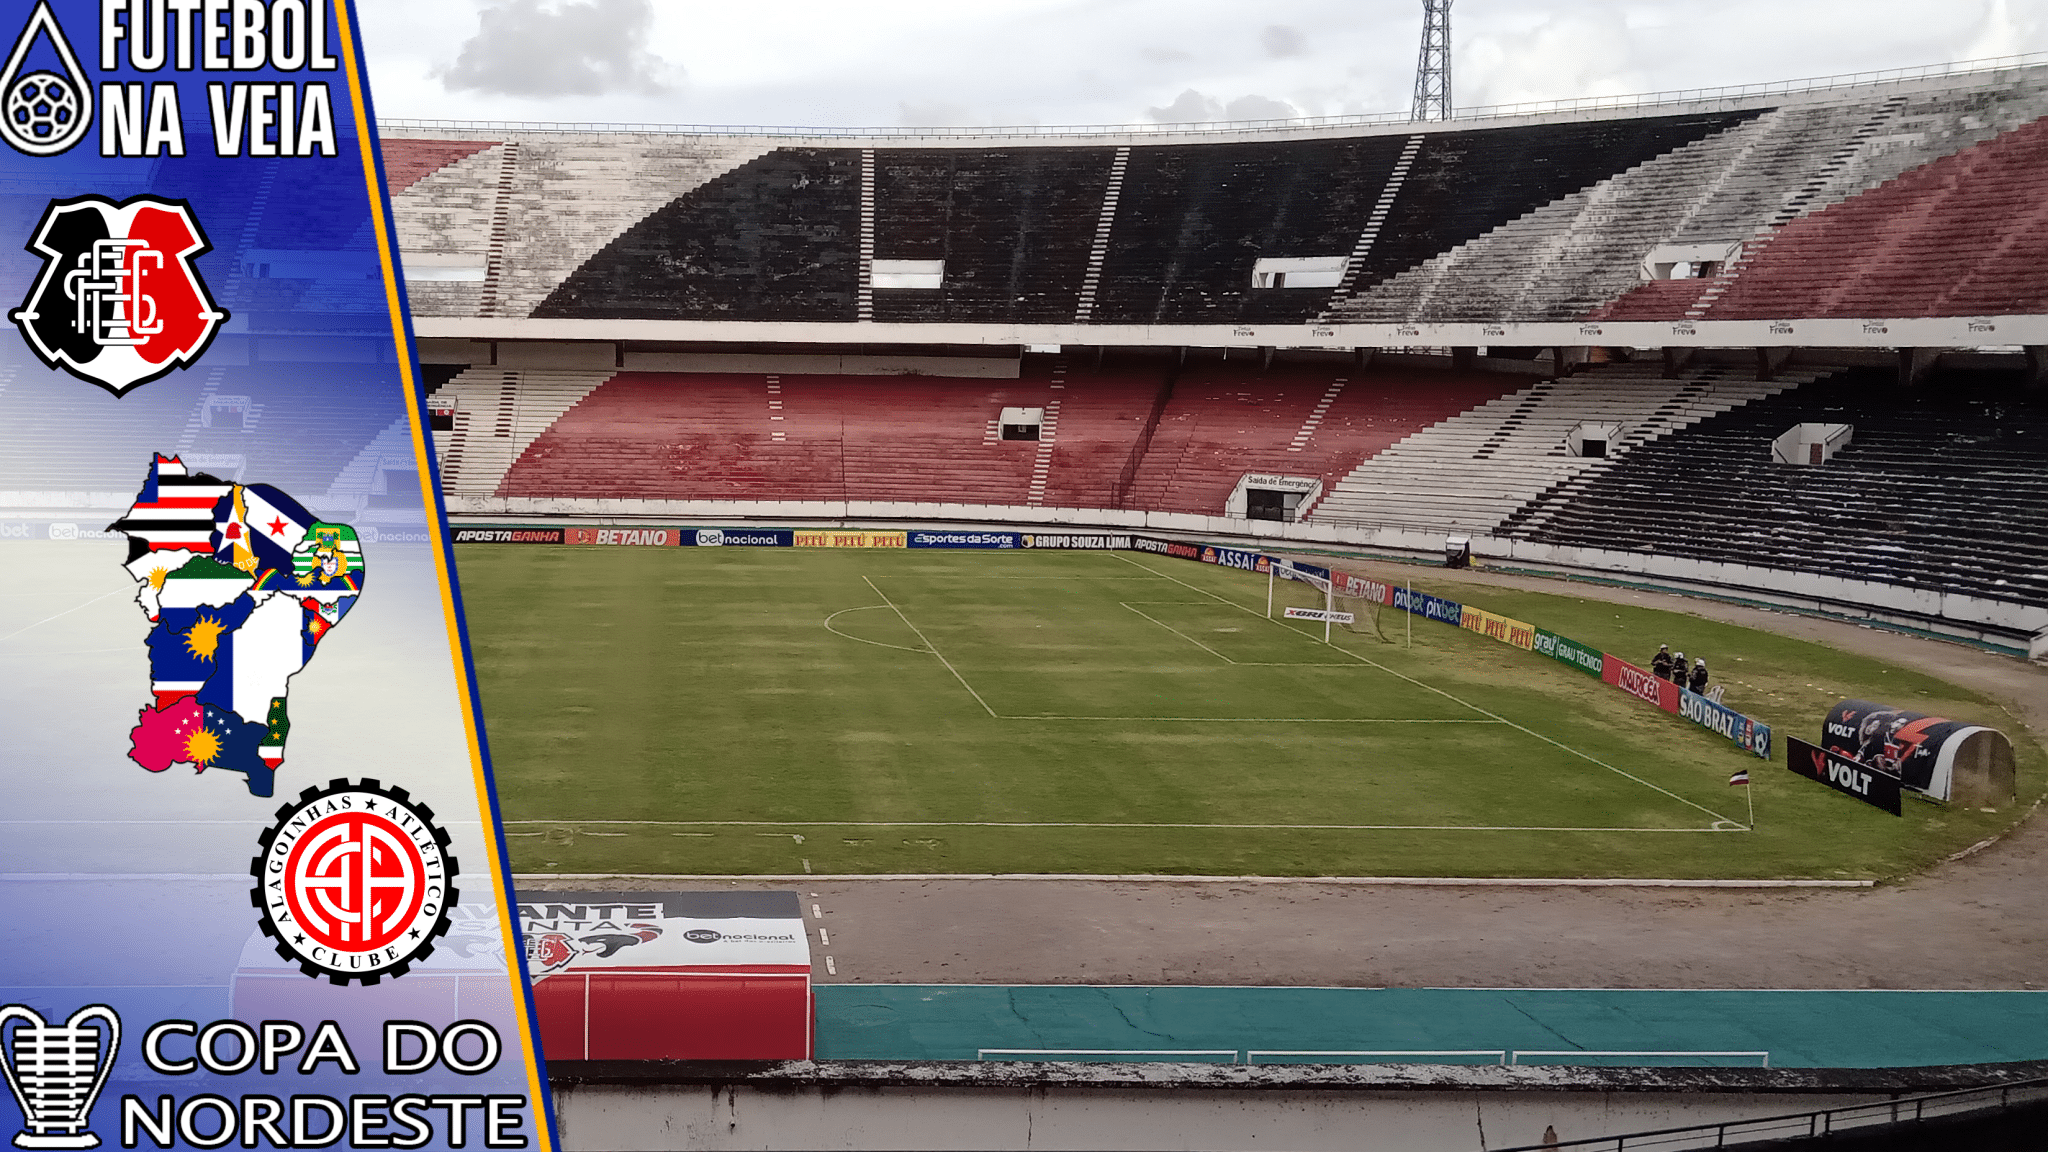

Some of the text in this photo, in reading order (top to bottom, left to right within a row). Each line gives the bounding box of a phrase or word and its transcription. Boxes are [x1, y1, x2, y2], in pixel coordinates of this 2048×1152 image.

[596, 529, 667, 546] BETANO
[1035, 536, 1131, 549] GRUPO SOUZA LIMA
[1346, 576, 1386, 603] BETANO
[1558, 643, 1576, 662] GRAU
[1703, 705, 1734, 739] BRAZ
[1828, 721, 1857, 739] VOLT
[1827, 758, 1873, 796] VOLT
